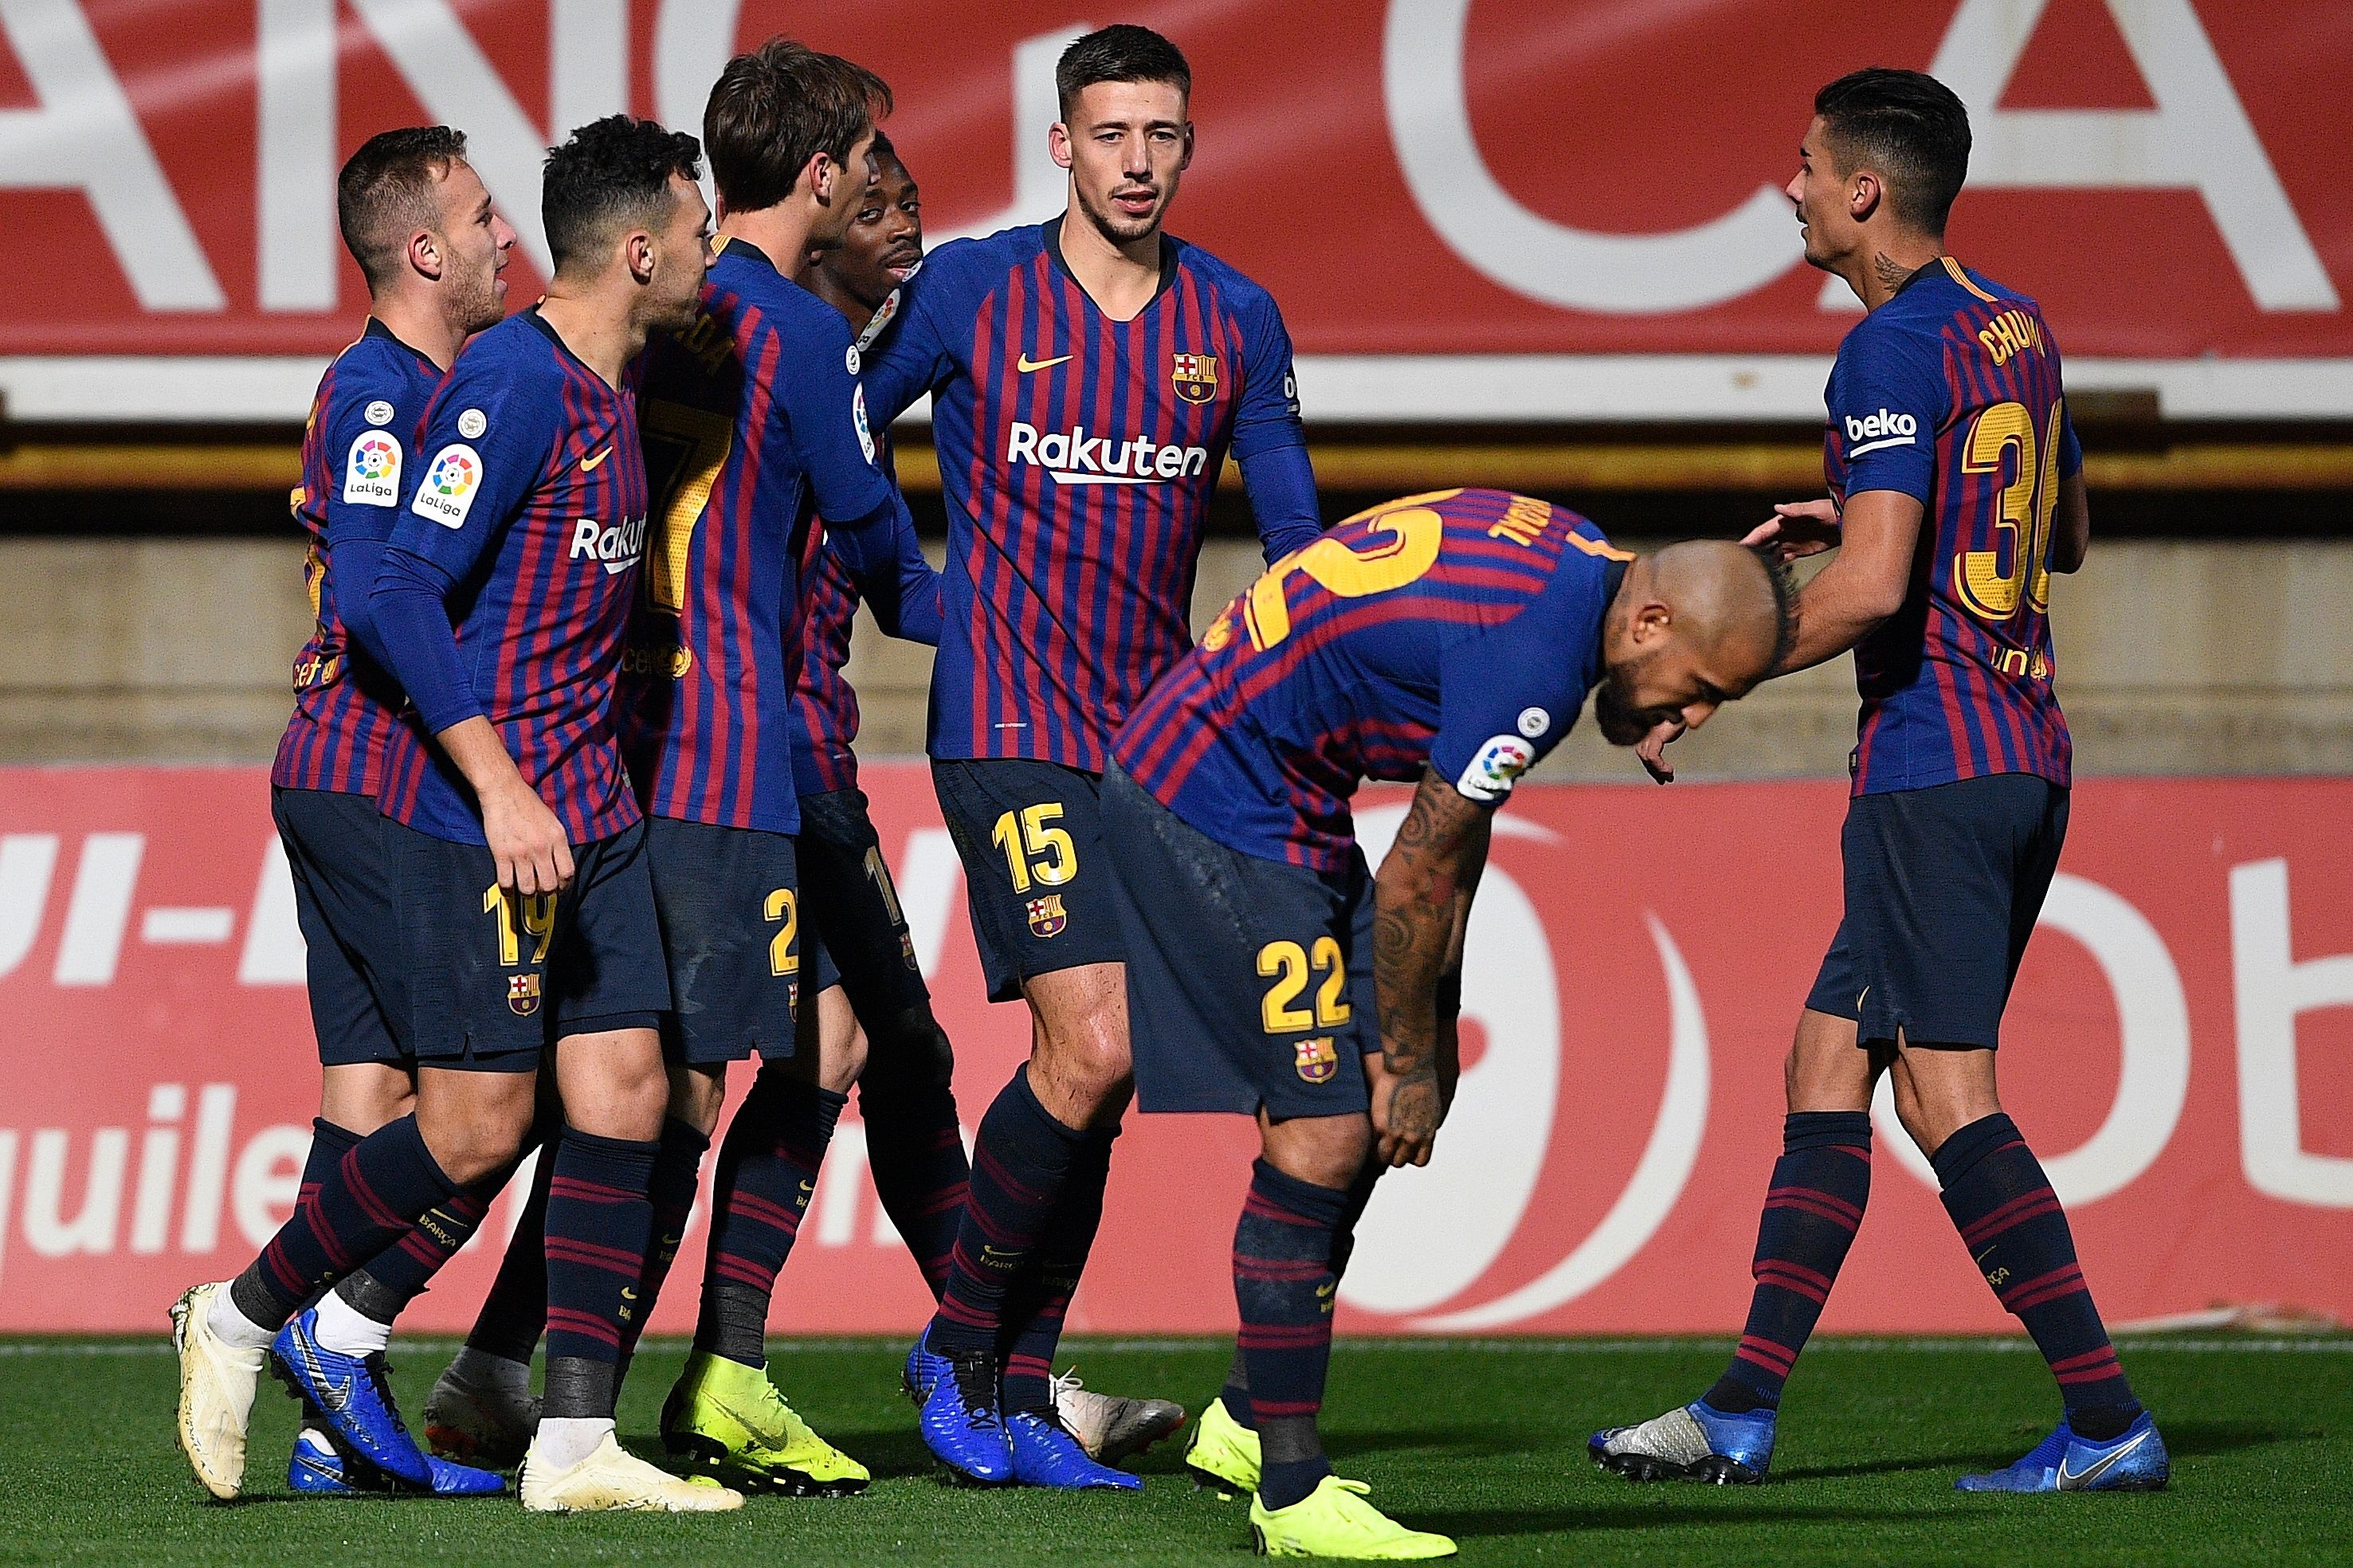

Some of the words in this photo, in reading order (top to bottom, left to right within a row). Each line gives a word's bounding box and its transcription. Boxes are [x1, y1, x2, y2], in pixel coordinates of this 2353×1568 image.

[1007, 421, 1208, 479] Rakuten
[1845, 408, 1917, 442] beko
[350, 482, 393, 496] LaLiga
[420, 492, 461, 517] LaLiga
[991, 802, 1078, 895] 15
[483, 882, 558, 966] 19
[1255, 935, 1351, 1035] 22
